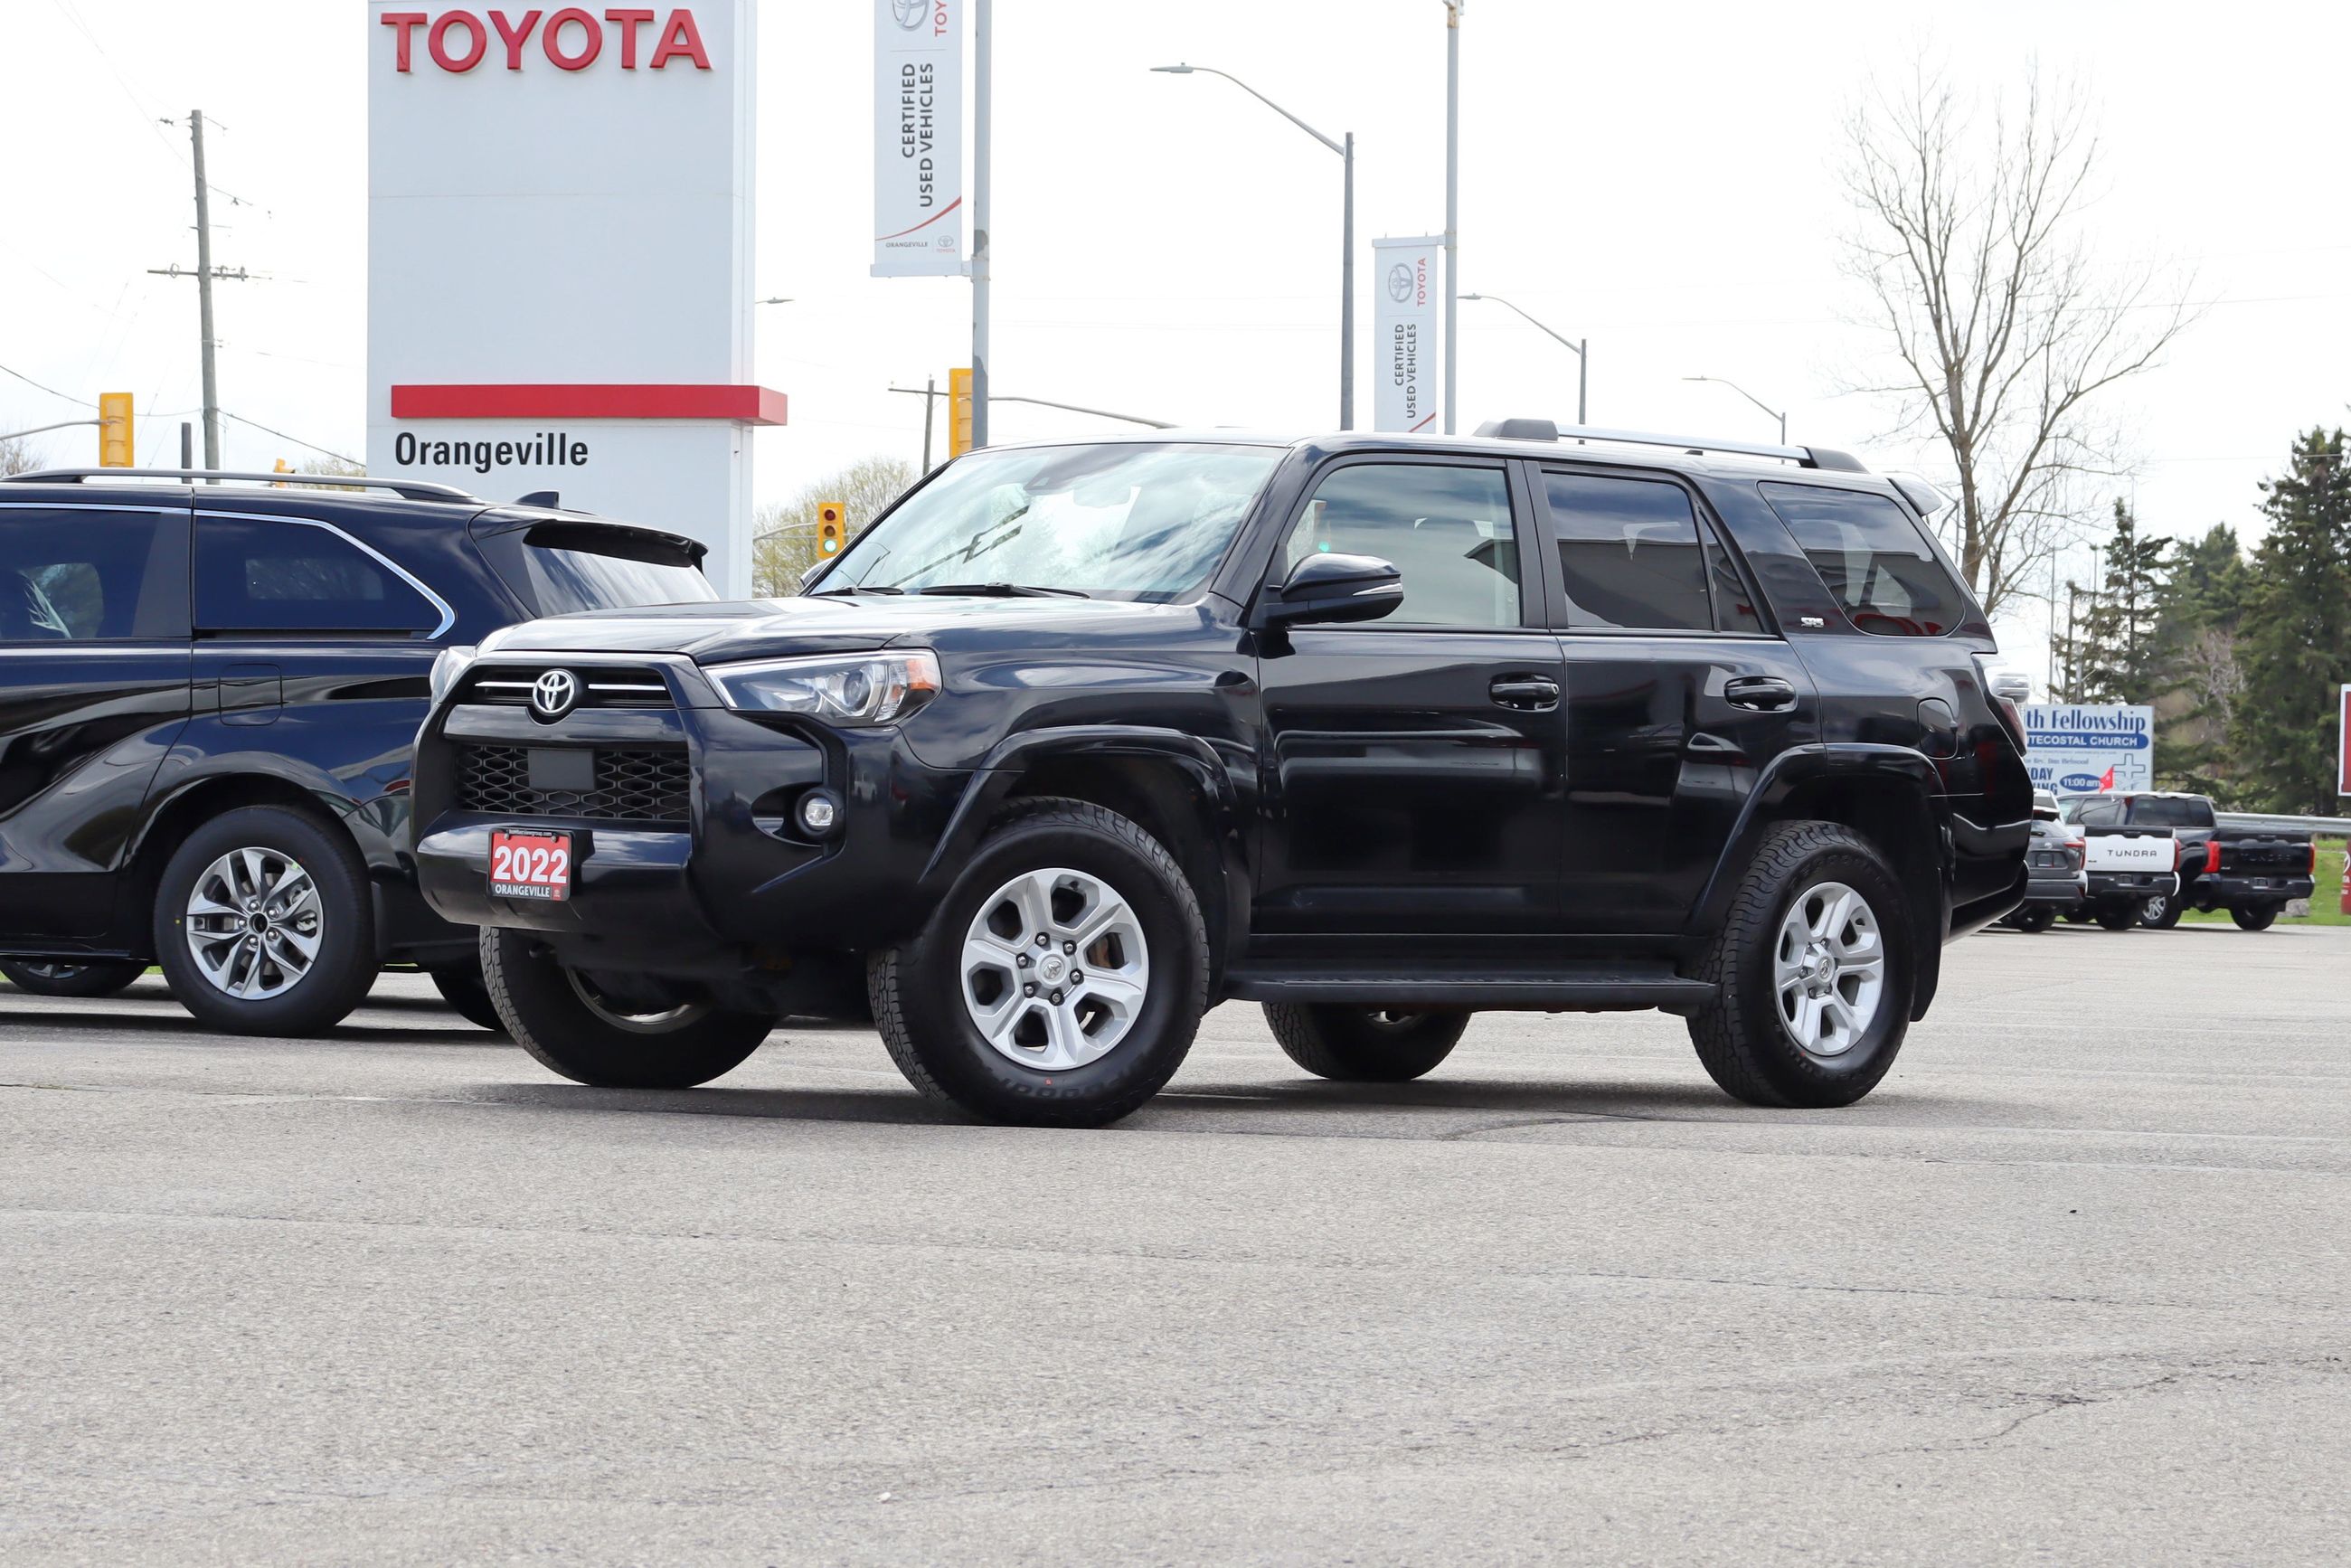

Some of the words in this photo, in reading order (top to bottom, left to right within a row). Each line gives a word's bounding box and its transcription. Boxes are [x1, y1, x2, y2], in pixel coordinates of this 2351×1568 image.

[935, 0, 947, 37] TOY
[381, 7, 712, 73] TOYOTA
[902, 63, 916, 158] CERTIFIED
[920, 62, 933, 153] VEHICLES
[920, 157, 933, 207] USED
[1417, 258, 1426, 307] TOYOTA
[1394, 324, 1404, 386] CERTIFIED
[1407, 324, 1417, 383] VEHICLES
[1407, 385, 1417, 419] USED
[394, 432, 589, 473] Orangeville
[2026, 709, 2044, 729] th
[2051, 709, 2146, 734] Fellowship
[2090, 737, 2138, 746] CHURCH
[2027, 767, 2054, 780] DAY
[2063, 778, 2085, 787] 11:00
[493, 845, 568, 884] 2022
[2108, 849, 2157, 857] TUNDRA
[495, 883, 550, 897] ORANGEVILLE
